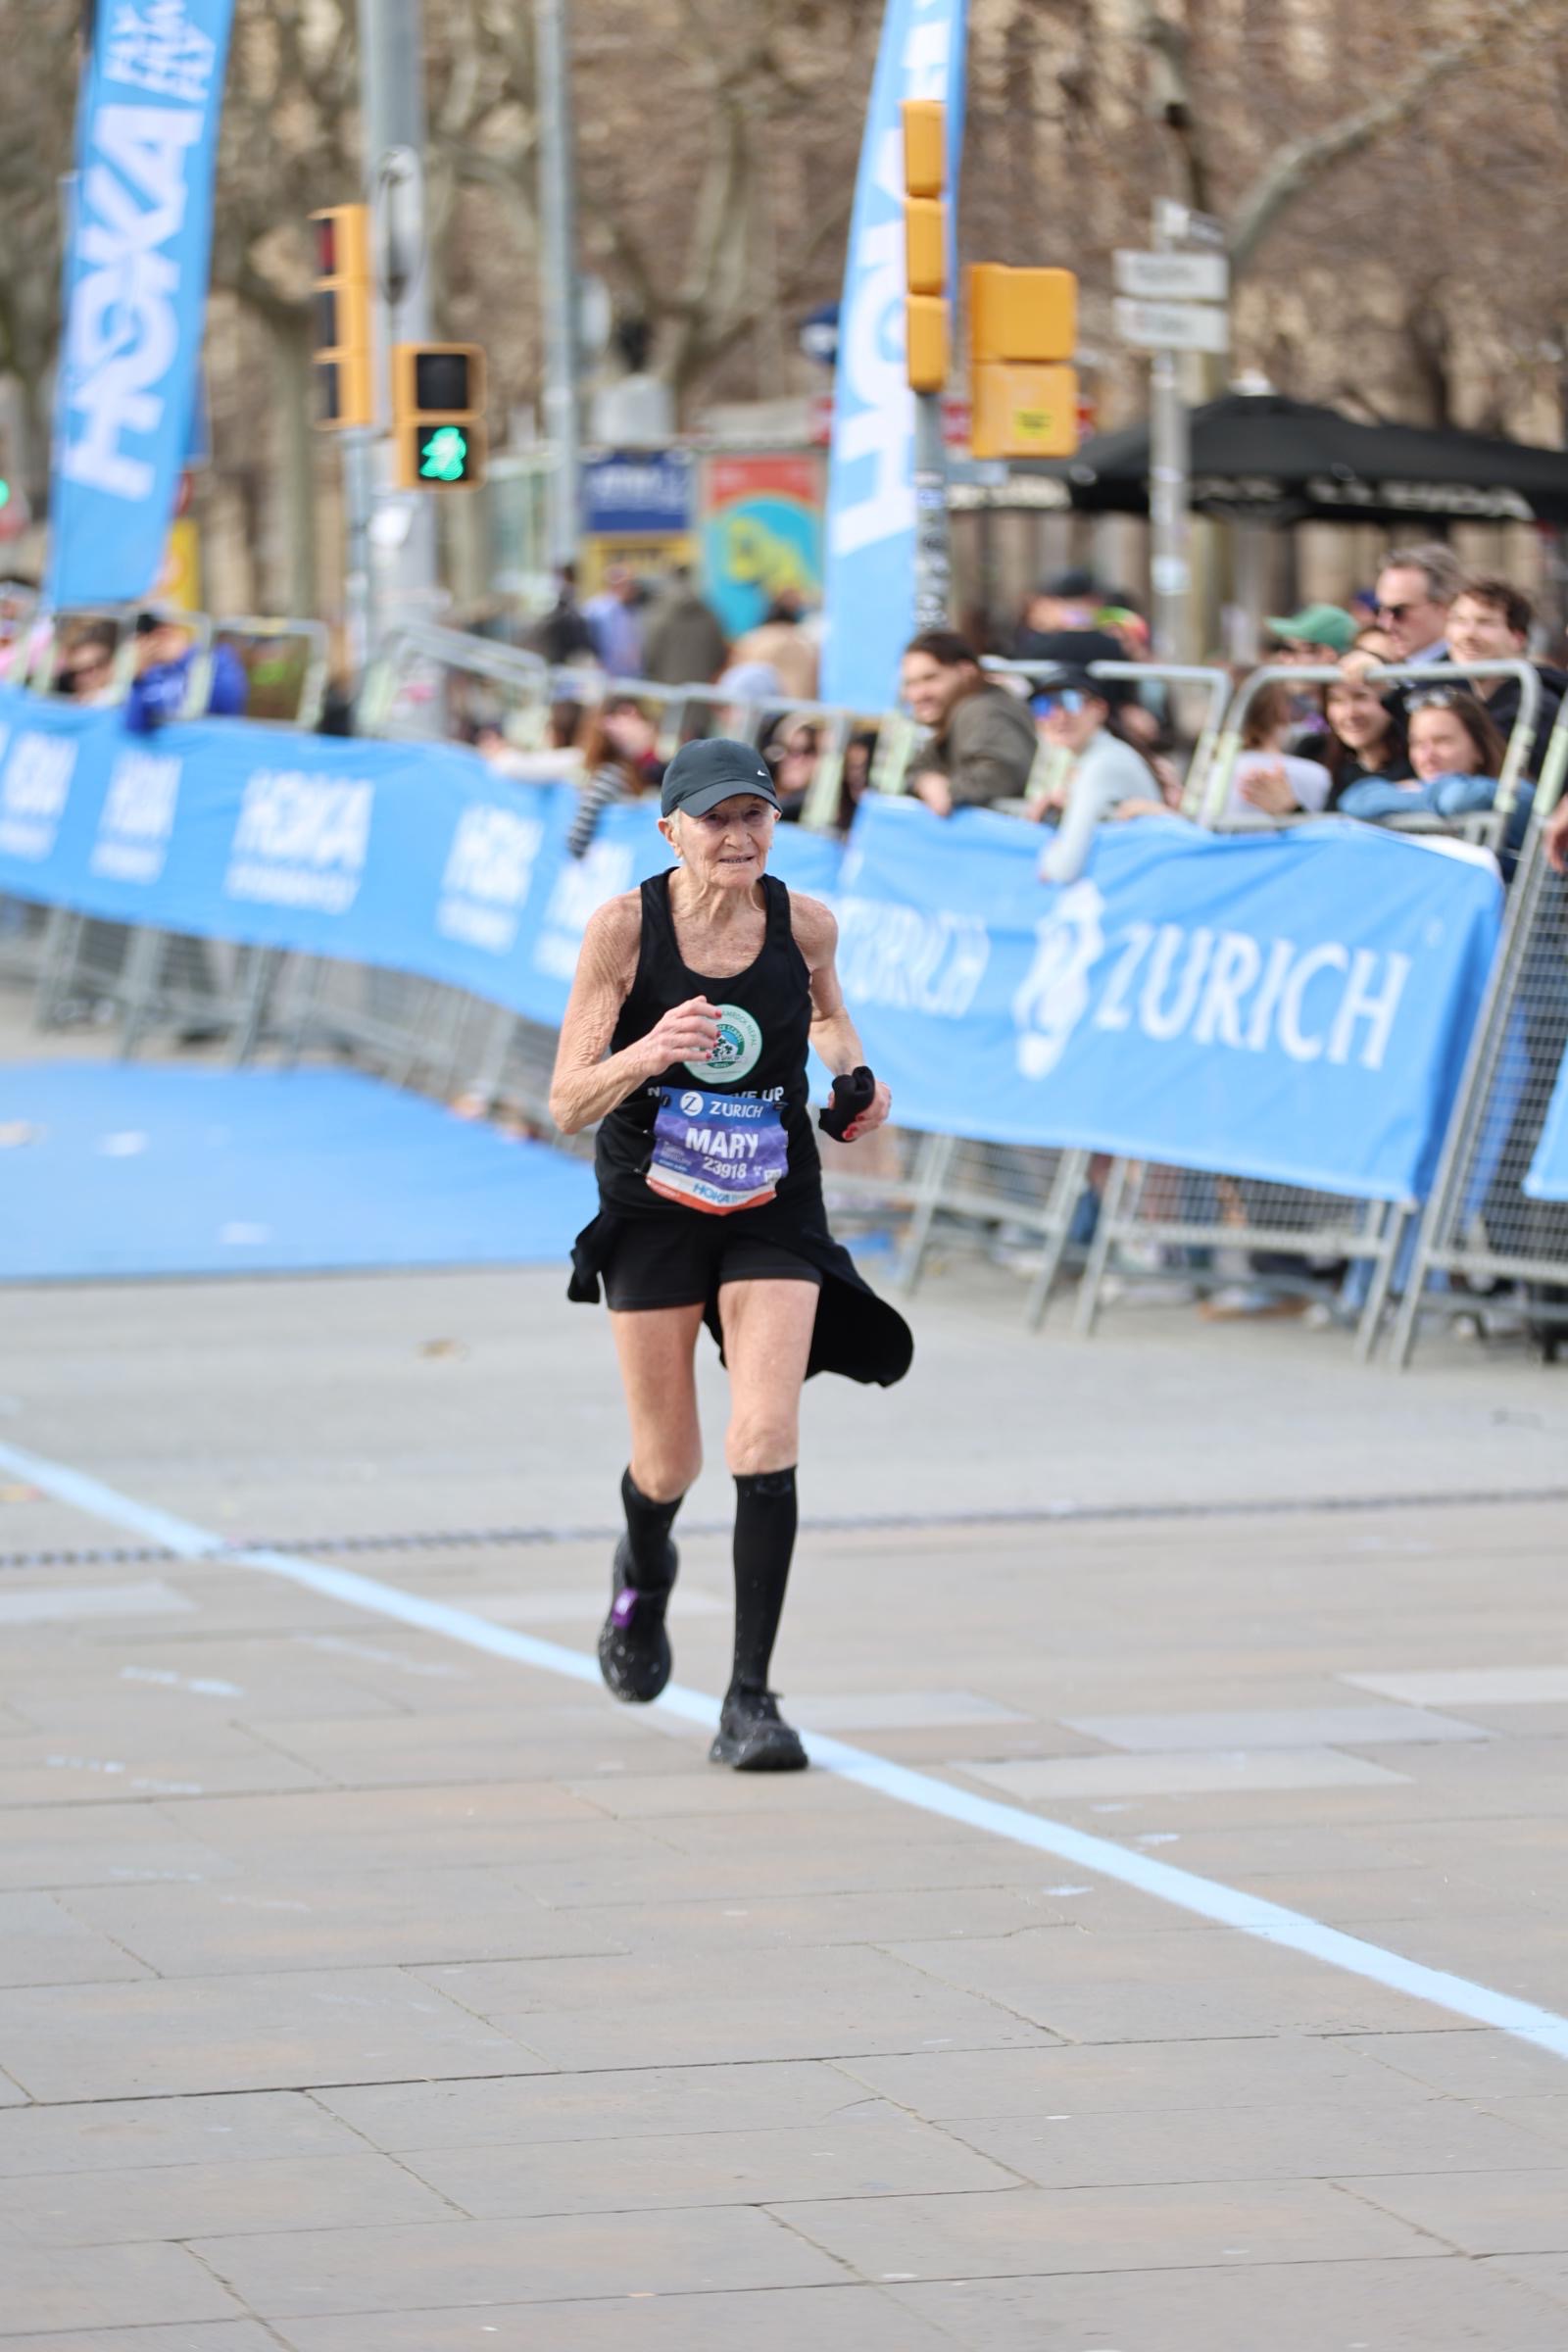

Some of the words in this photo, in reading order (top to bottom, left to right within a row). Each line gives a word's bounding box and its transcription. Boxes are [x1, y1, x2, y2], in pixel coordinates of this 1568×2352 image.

[63, 103, 205, 503] HOKA
[1095, 923, 1410, 1069] ZURICH
[761, 1086, 785, 1102] UP
[710, 1101, 764, 1118] ZURICH
[685, 1127, 760, 1159] MARY
[702, 1156, 748, 1179] 23918
[693, 1182, 730, 1203] HOKA
